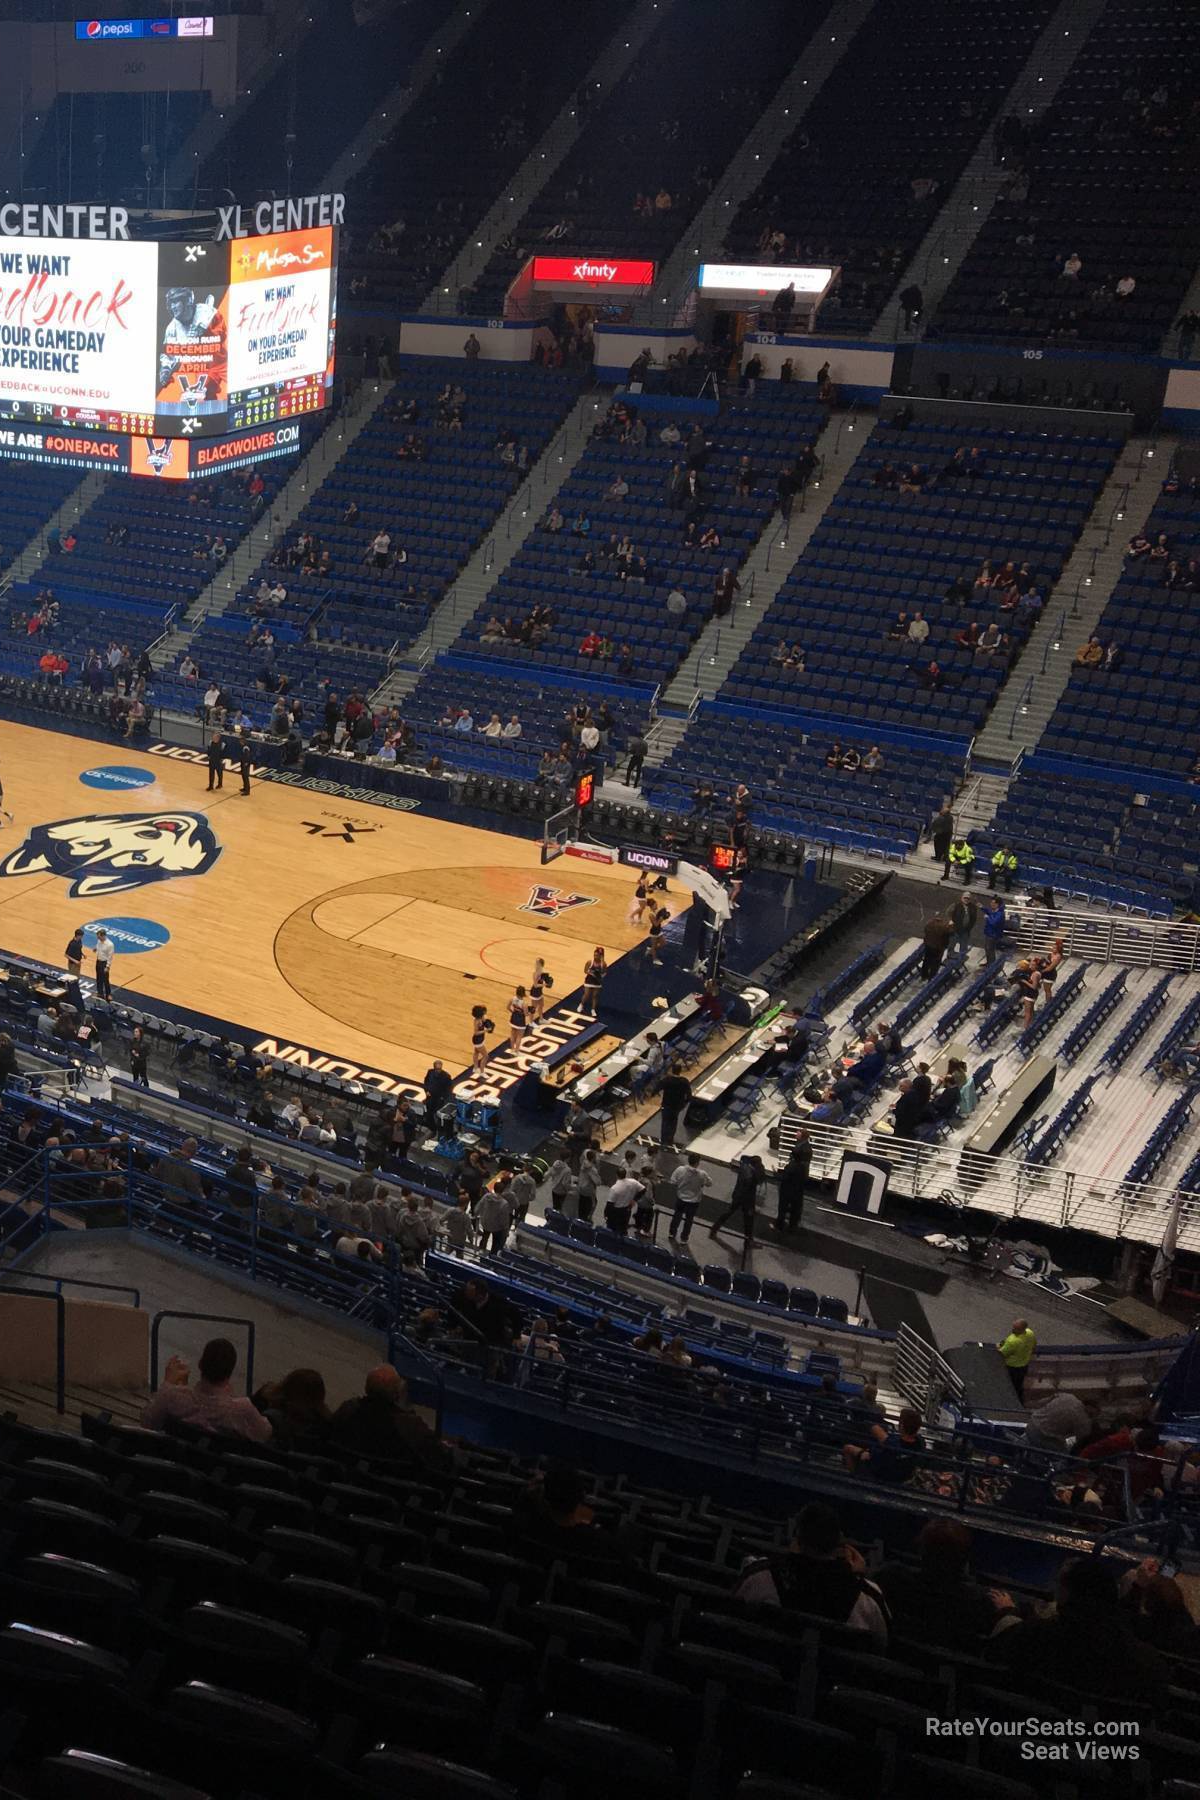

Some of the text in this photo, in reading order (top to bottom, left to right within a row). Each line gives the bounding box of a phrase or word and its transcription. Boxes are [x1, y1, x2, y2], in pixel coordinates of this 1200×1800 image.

[103, 22, 133, 36] pepsi
[0, 203, 131, 240] CENTER
[218, 193, 346, 241] XL CENTER
[0, 253, 71, 276] WE WANT
[256, 244, 325, 272] Mohegan Sun
[573, 262, 618, 280] xfinity
[264, 284, 296, 303] WE WANT
[35, 328, 106, 353] GAMEDAY
[166, 344, 221, 354] DECEMBER
[248, 328, 308, 353] ON YOUR GAMEDAY
[756, 335, 776, 345] 104
[258, 345, 297, 365] EXPERIENCE
[1022, 350, 1044, 360] 105
[180, 362, 208, 372] APRIL
[12, 401, 19, 412] 0
[60, 406, 68, 417] 0
[17, 433, 44, 449] ARE
[46, 436, 119, 458] #ONEPACK
[198, 424, 300, 465] BLACKWOLVES.COM
[258, 768, 422, 812] HUSKIES
[627, 851, 669, 868] UCONN
[452, 1008, 598, 1100] HUSKIES
[252, 1038, 428, 1102] UCONN
